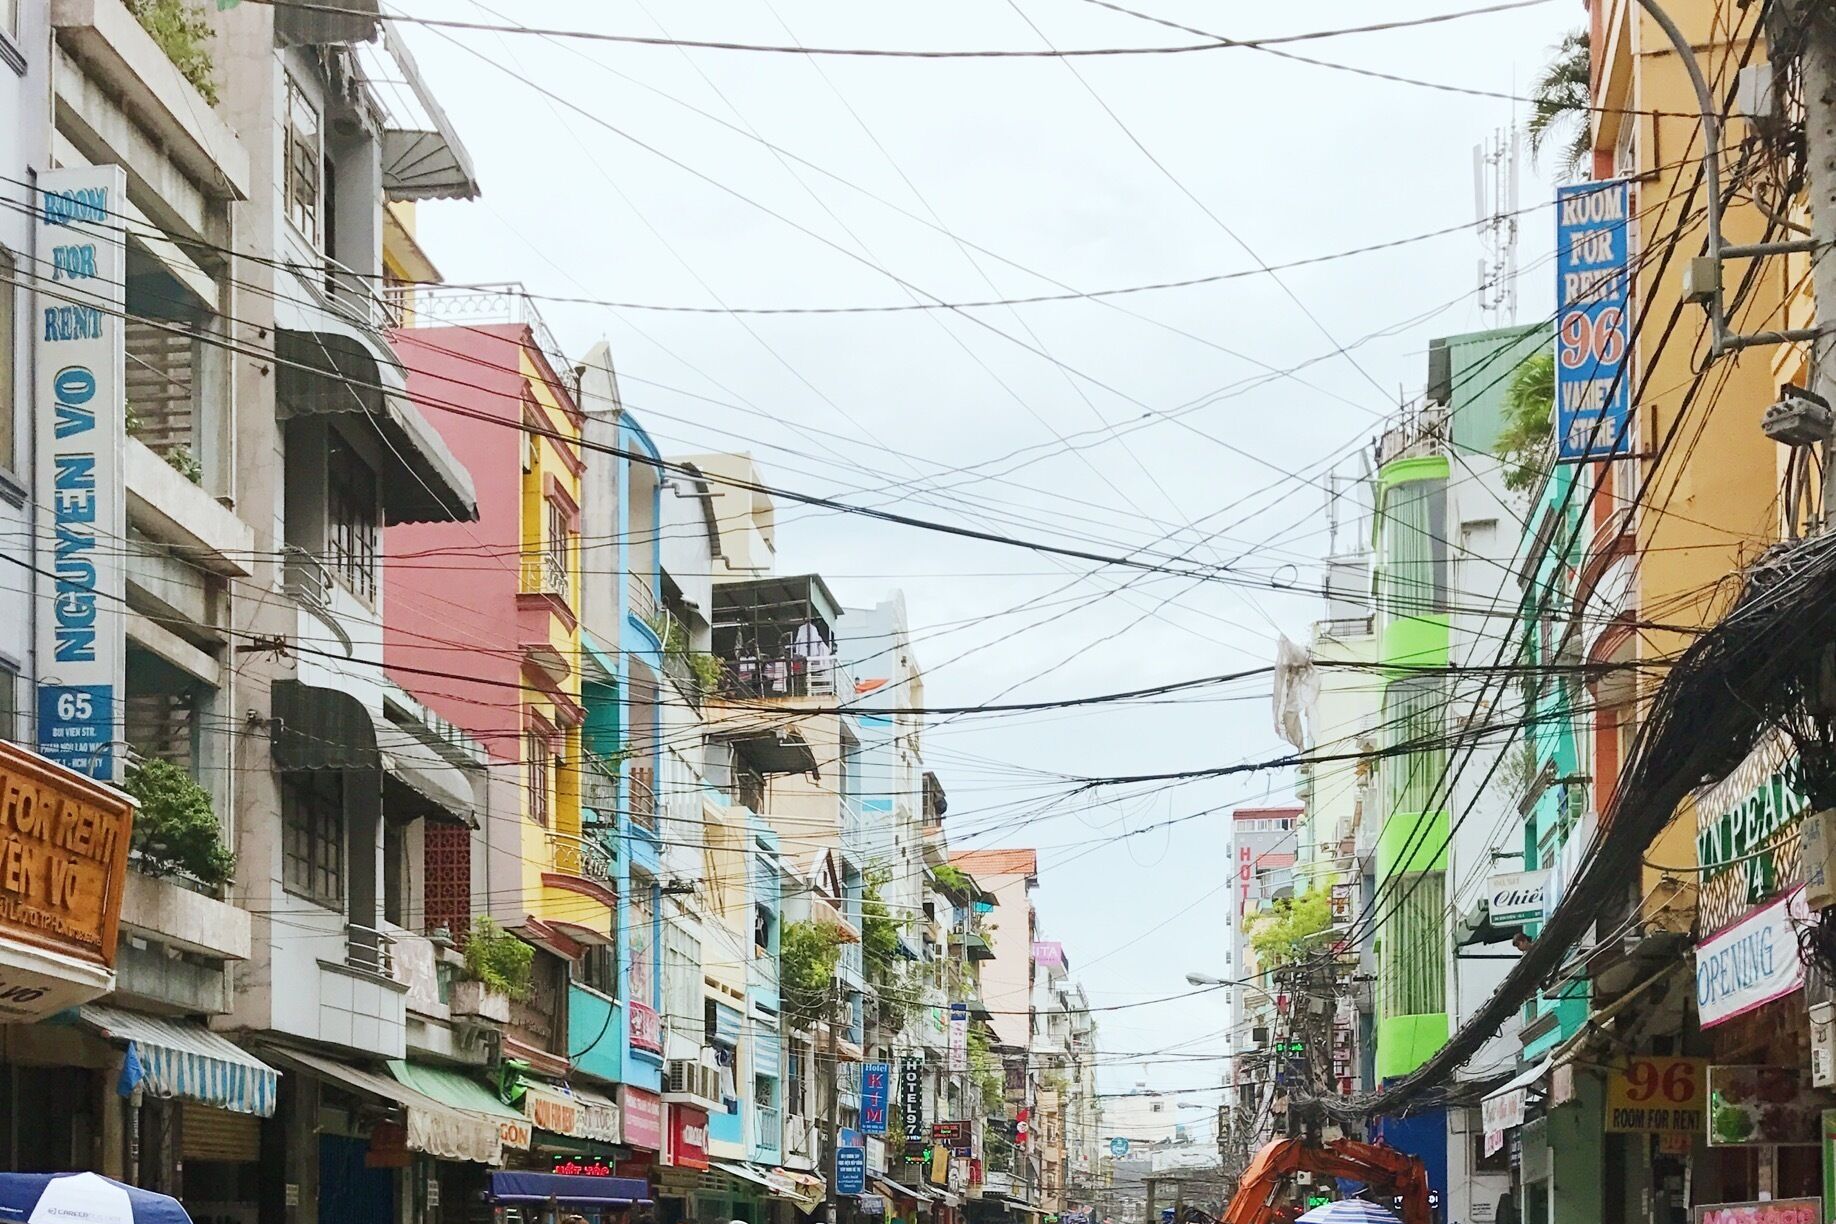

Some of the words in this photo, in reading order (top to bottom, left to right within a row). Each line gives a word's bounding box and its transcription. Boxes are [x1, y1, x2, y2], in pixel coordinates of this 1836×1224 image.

[43, 186, 108, 226] ROOM
[1562, 186, 1623, 226] ROOM
[52, 243, 98, 281] FOR
[1569, 228, 1613, 267] FOR
[1564, 267, 1622, 305] RENT
[43, 303, 105, 342] RENT
[1560, 306, 1626, 370] 96
[54, 364, 97, 440] VO
[1561, 377, 1622, 413] VARIETY
[1567, 416, 1617, 450] STORE
[54, 452, 97, 663] NGUYEN
[57, 692, 93, 721] 65
[1, 780, 53, 841] FOR
[57, 798, 117, 863] RENT
[1697, 926, 1775, 1006] OPENING
[865, 1063, 888, 1073] Hotel
[1625, 1060, 1696, 1103] 96
[1613, 1108, 1645, 1129] ROOM
[1647, 1108, 1669, 1129] FOR
[1672, 1108, 1702, 1130] RENT
